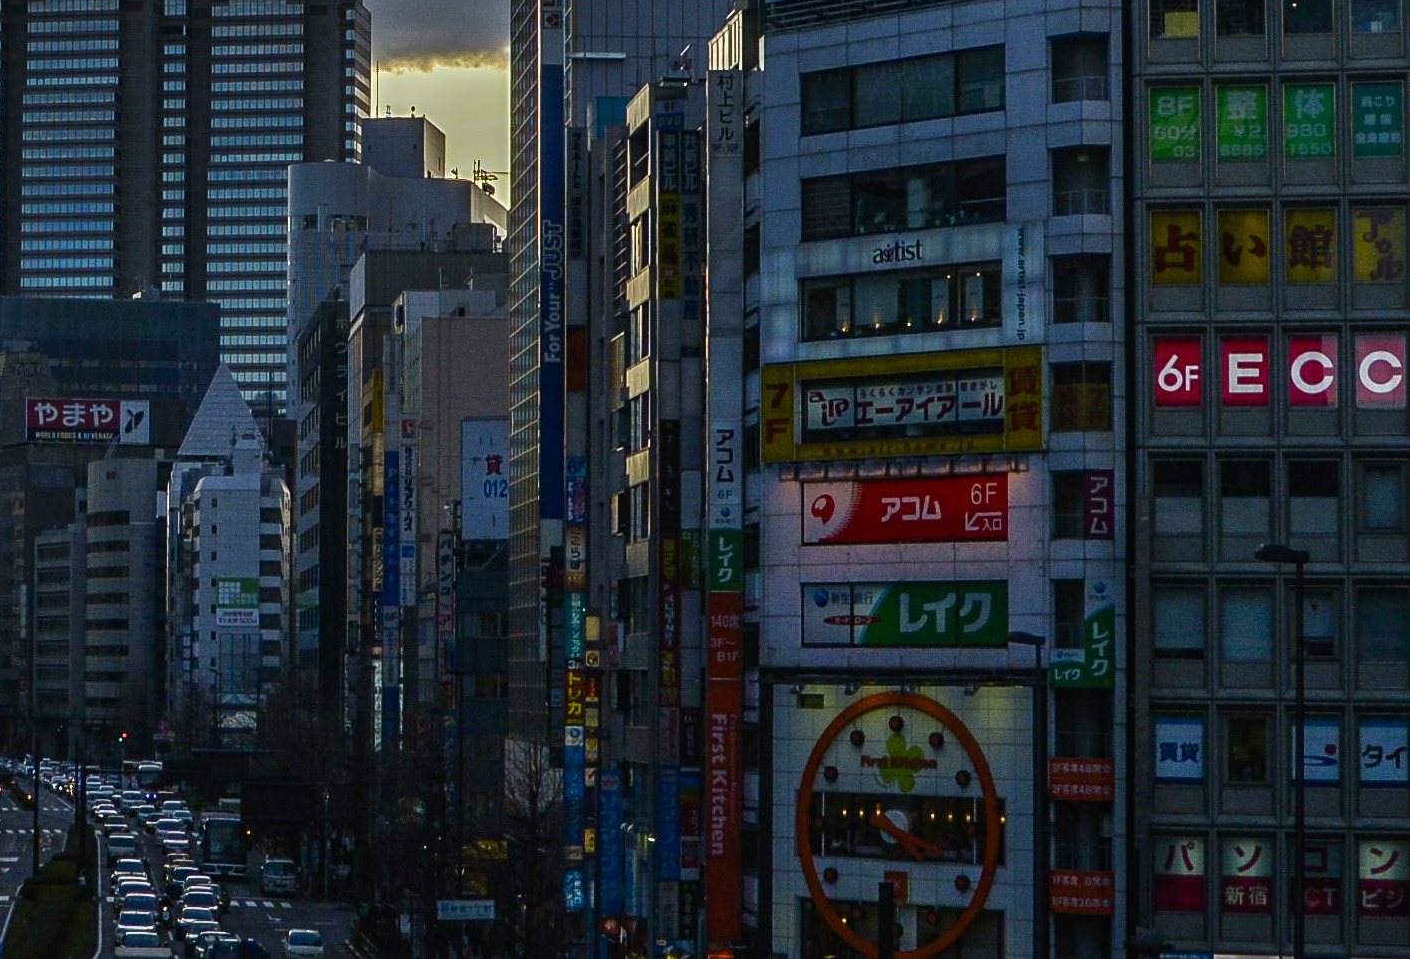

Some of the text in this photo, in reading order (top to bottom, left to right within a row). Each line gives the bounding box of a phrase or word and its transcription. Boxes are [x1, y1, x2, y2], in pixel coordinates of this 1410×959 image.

[717, 74, 734, 141] 村上ビル
[1156, 95, 1194, 117] 8F
[1157, 350, 1403, 395] 6F ECC
[34, 402, 114, 427] やまや
[764, 382, 790, 445] 7F
[715, 429, 734, 482] アコム
[880, 495, 942, 522] アコム
[970, 482, 998, 506] 6F
[1089, 475, 1110, 536] アコム
[717, 536, 733, 583] レイク
[898, 592, 991, 634] レイク
[1091, 621, 1109, 677] レイク
[711, 713, 728, 855] First Kitchen
[1224, 885, 1268, 906] 新宿
